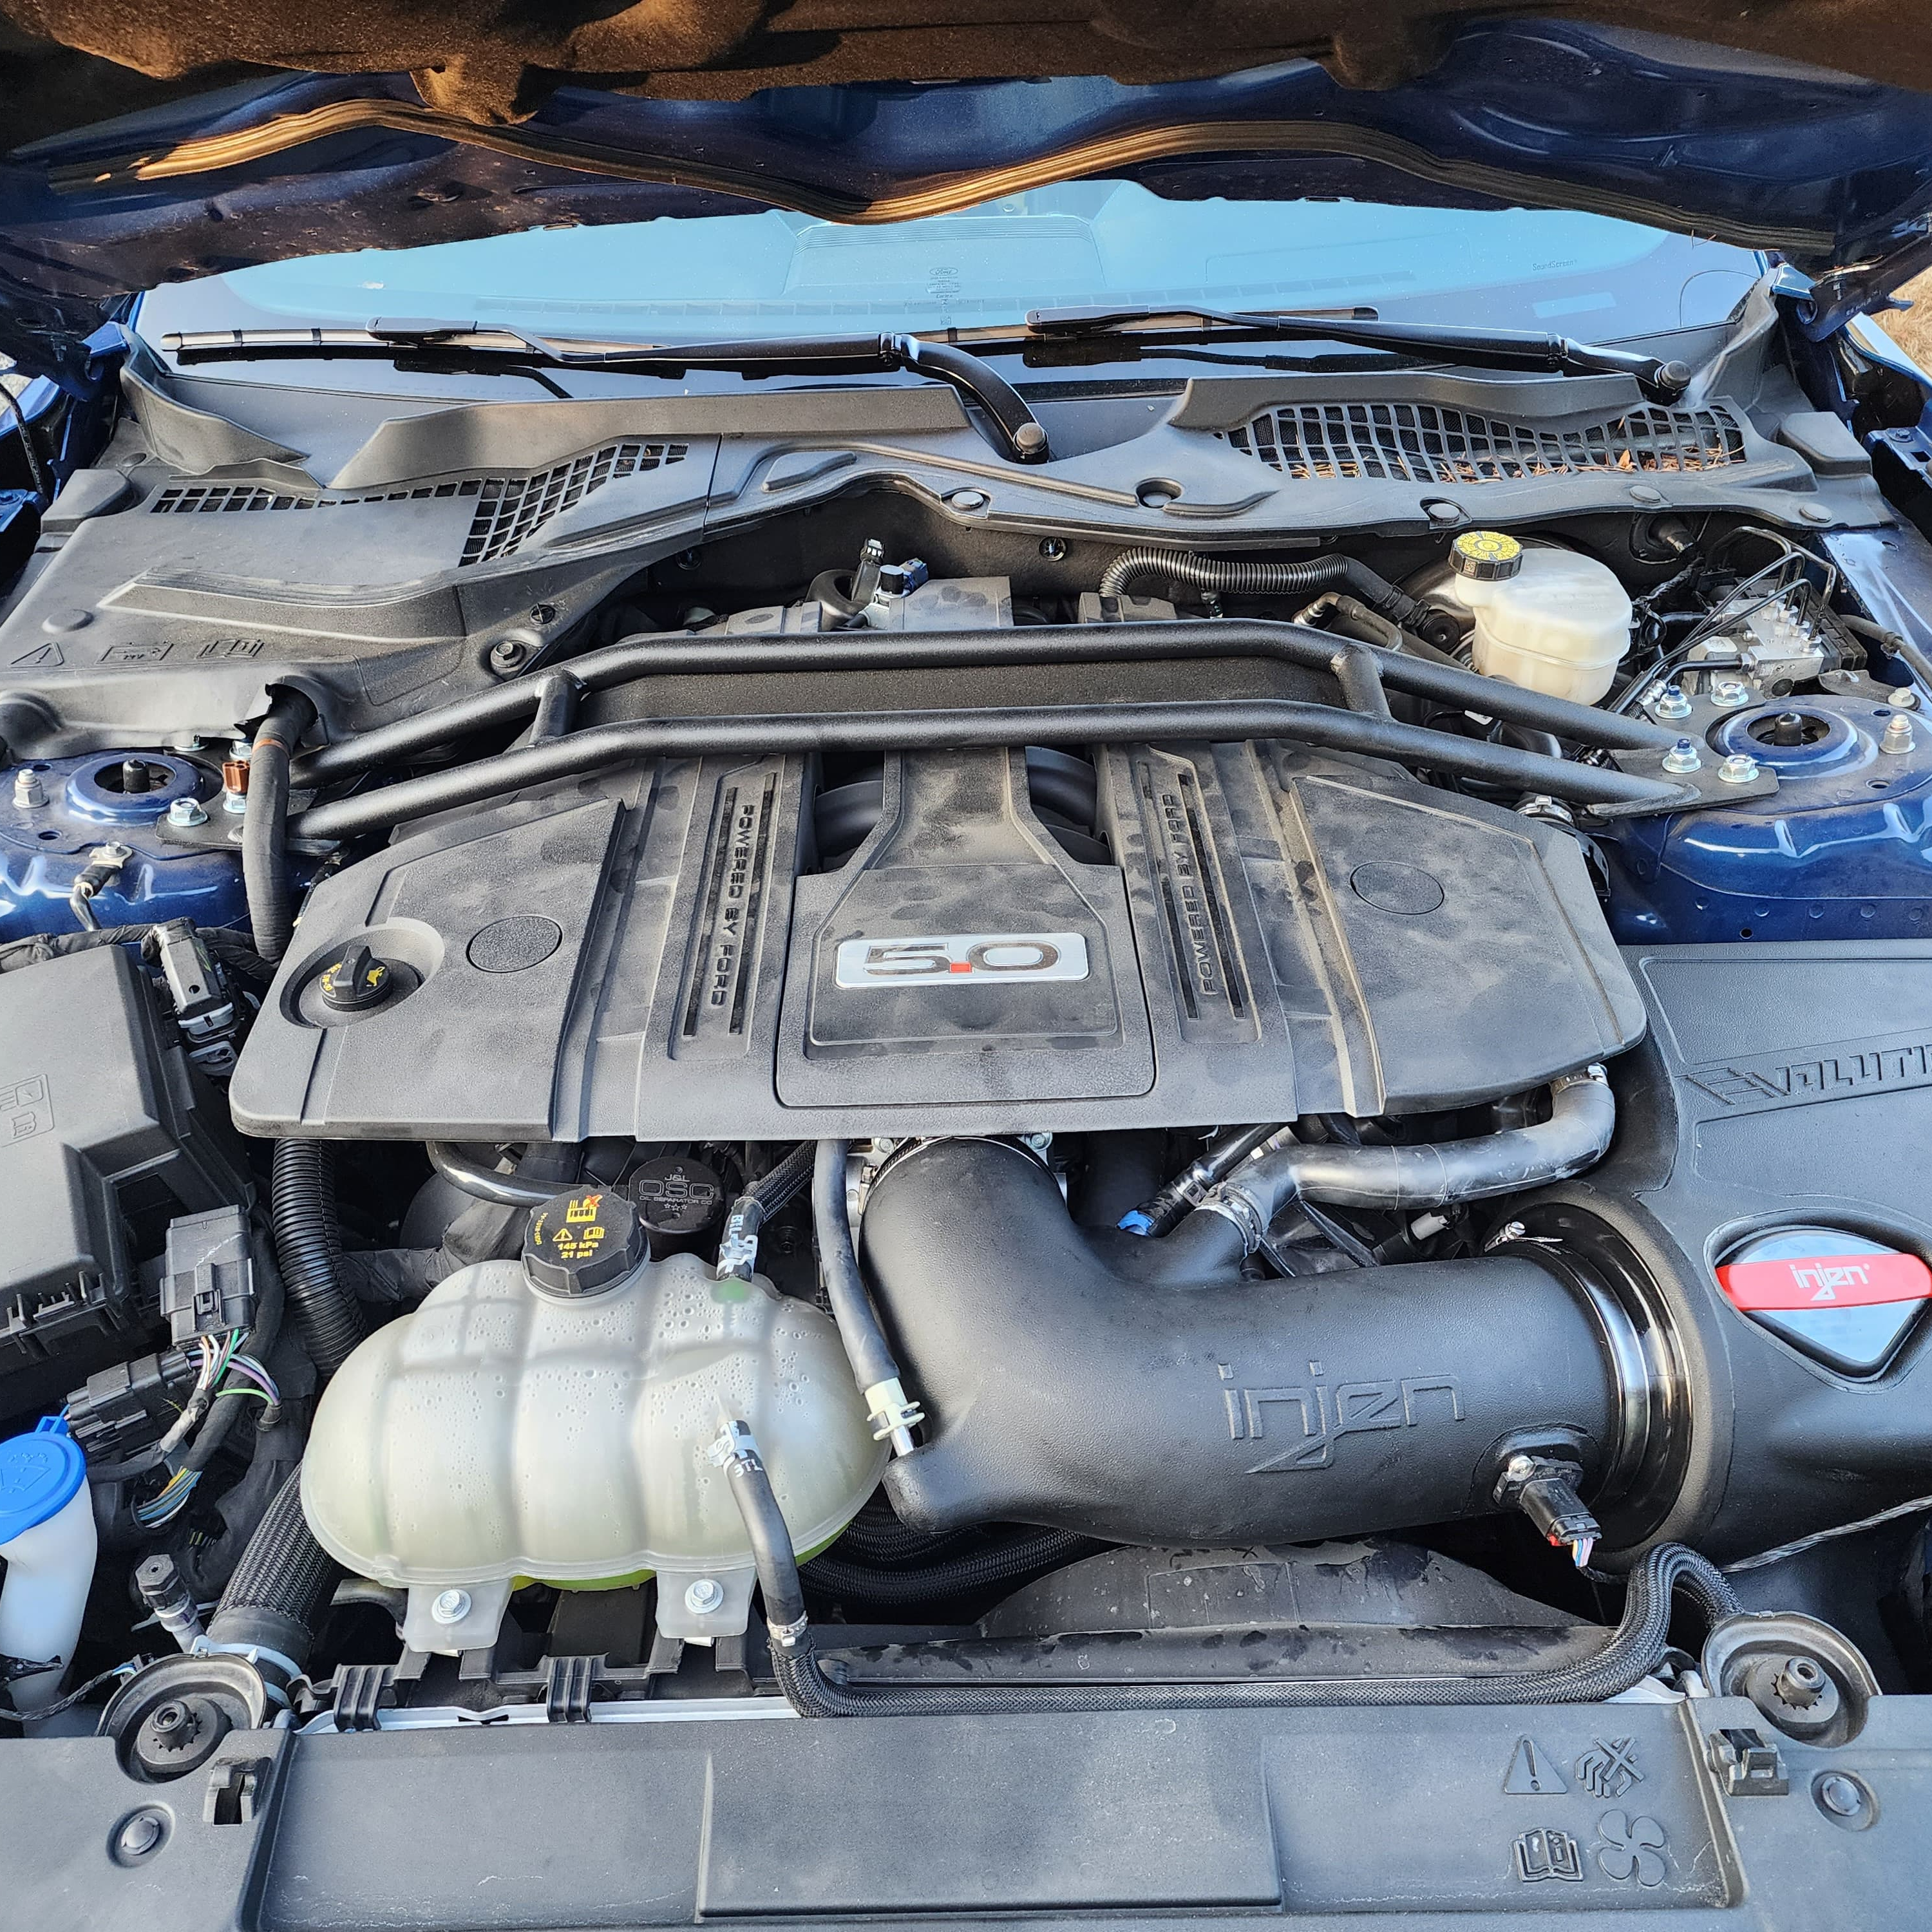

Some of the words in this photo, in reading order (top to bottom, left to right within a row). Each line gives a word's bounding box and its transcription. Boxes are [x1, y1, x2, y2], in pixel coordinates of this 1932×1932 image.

[1162, 793, 1188, 843] FORD
[728, 804, 755, 898] POWERED
[1173, 851, 1191, 878] BY
[723, 907, 739, 936] BY
[1182, 885, 1218, 995] POWERED
[710, 944, 734, 1005] FORD
[864, 940, 1061, 976] 5.0
[1674, 1044, 1932, 1105] EVOLUTI
[639, 1179, 714, 1200] OSC
[576, 1249, 593, 1258] psi
[1789, 1262, 1869, 1301] injen
[1218, 1360, 1466, 1474] injen
